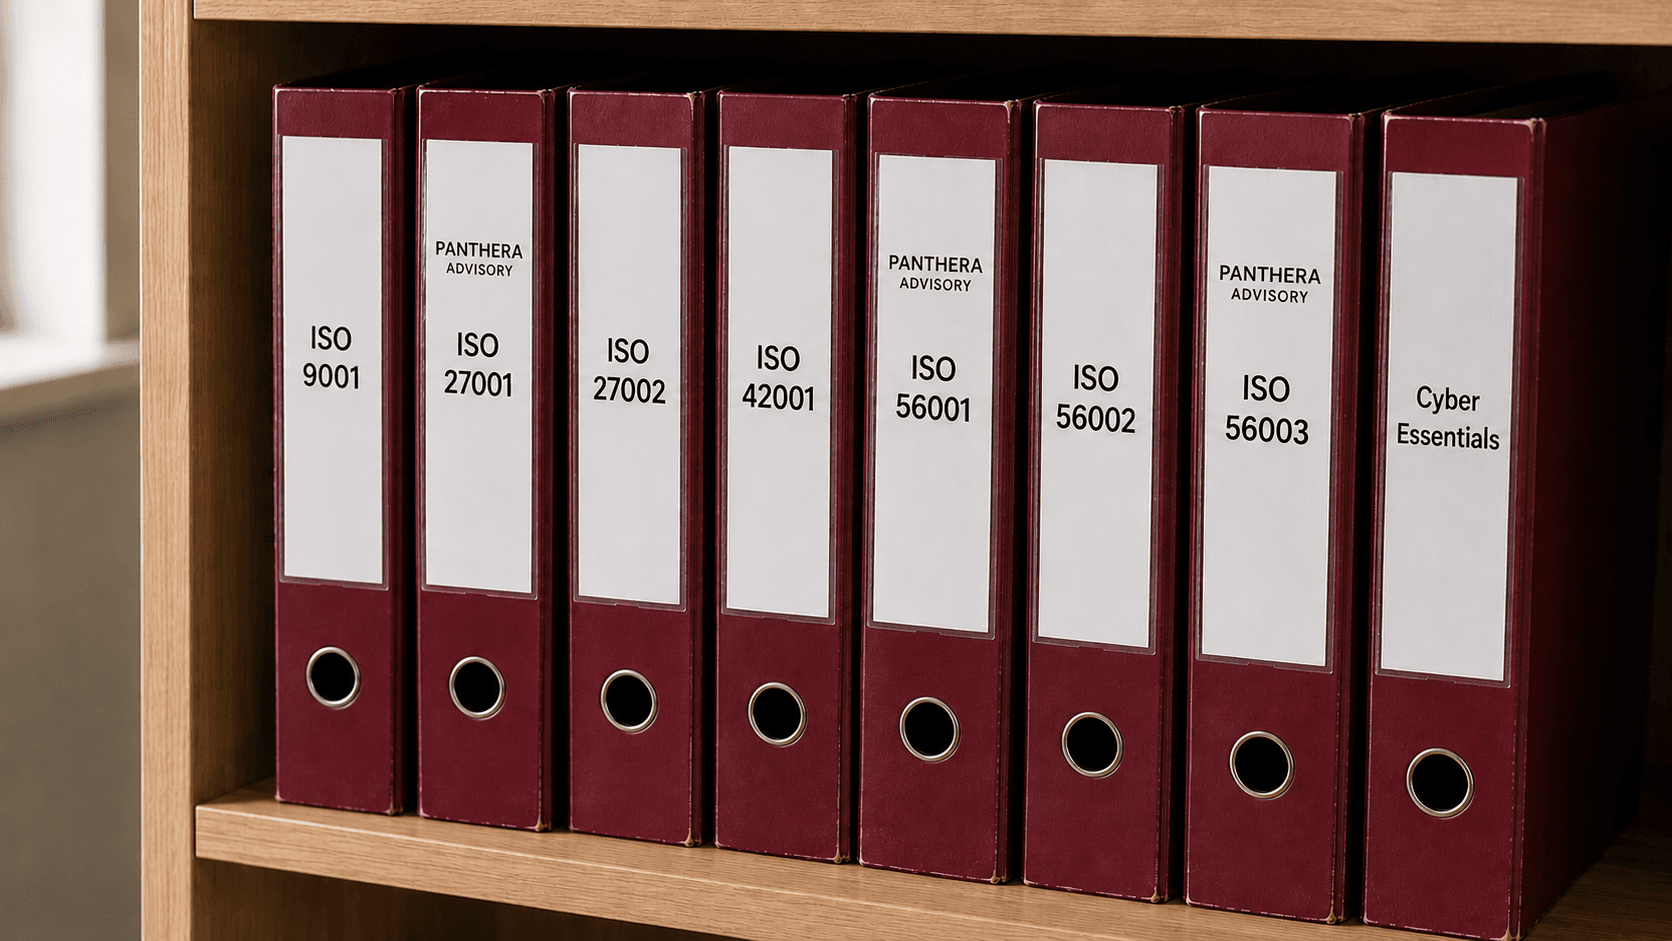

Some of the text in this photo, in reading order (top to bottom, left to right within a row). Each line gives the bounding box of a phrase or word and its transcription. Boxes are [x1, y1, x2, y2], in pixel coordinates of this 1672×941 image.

[435, 240, 524, 260] PANTHERA
[888, 254, 984, 274] PANTHERA
[445, 261, 513, 277] ADVISORY
[1219, 264, 1322, 285] PANTHERA
[899, 276, 972, 292] ADVISORY
[1230, 287, 1309, 304] ADVISORY
[311, 325, 352, 352] ISO
[457, 331, 499, 358] ISO
[607, 337, 650, 365] ISO
[757, 344, 801, 372] ISO
[911, 354, 957, 382] ISO
[302, 362, 359, 390] 9001
[444, 369, 512, 398] 27001
[593, 375, 666, 405] 27002
[1073, 363, 1119, 392] ISO
[1243, 374, 1291, 403] ISO
[741, 382, 814, 412] 42001
[895, 392, 970, 423] 56001
[1416, 385, 1481, 415] Cyber
[1056, 403, 1136, 434] 56002
[1225, 414, 1309, 446] 56003
[1397, 422, 1500, 451] Essentials
